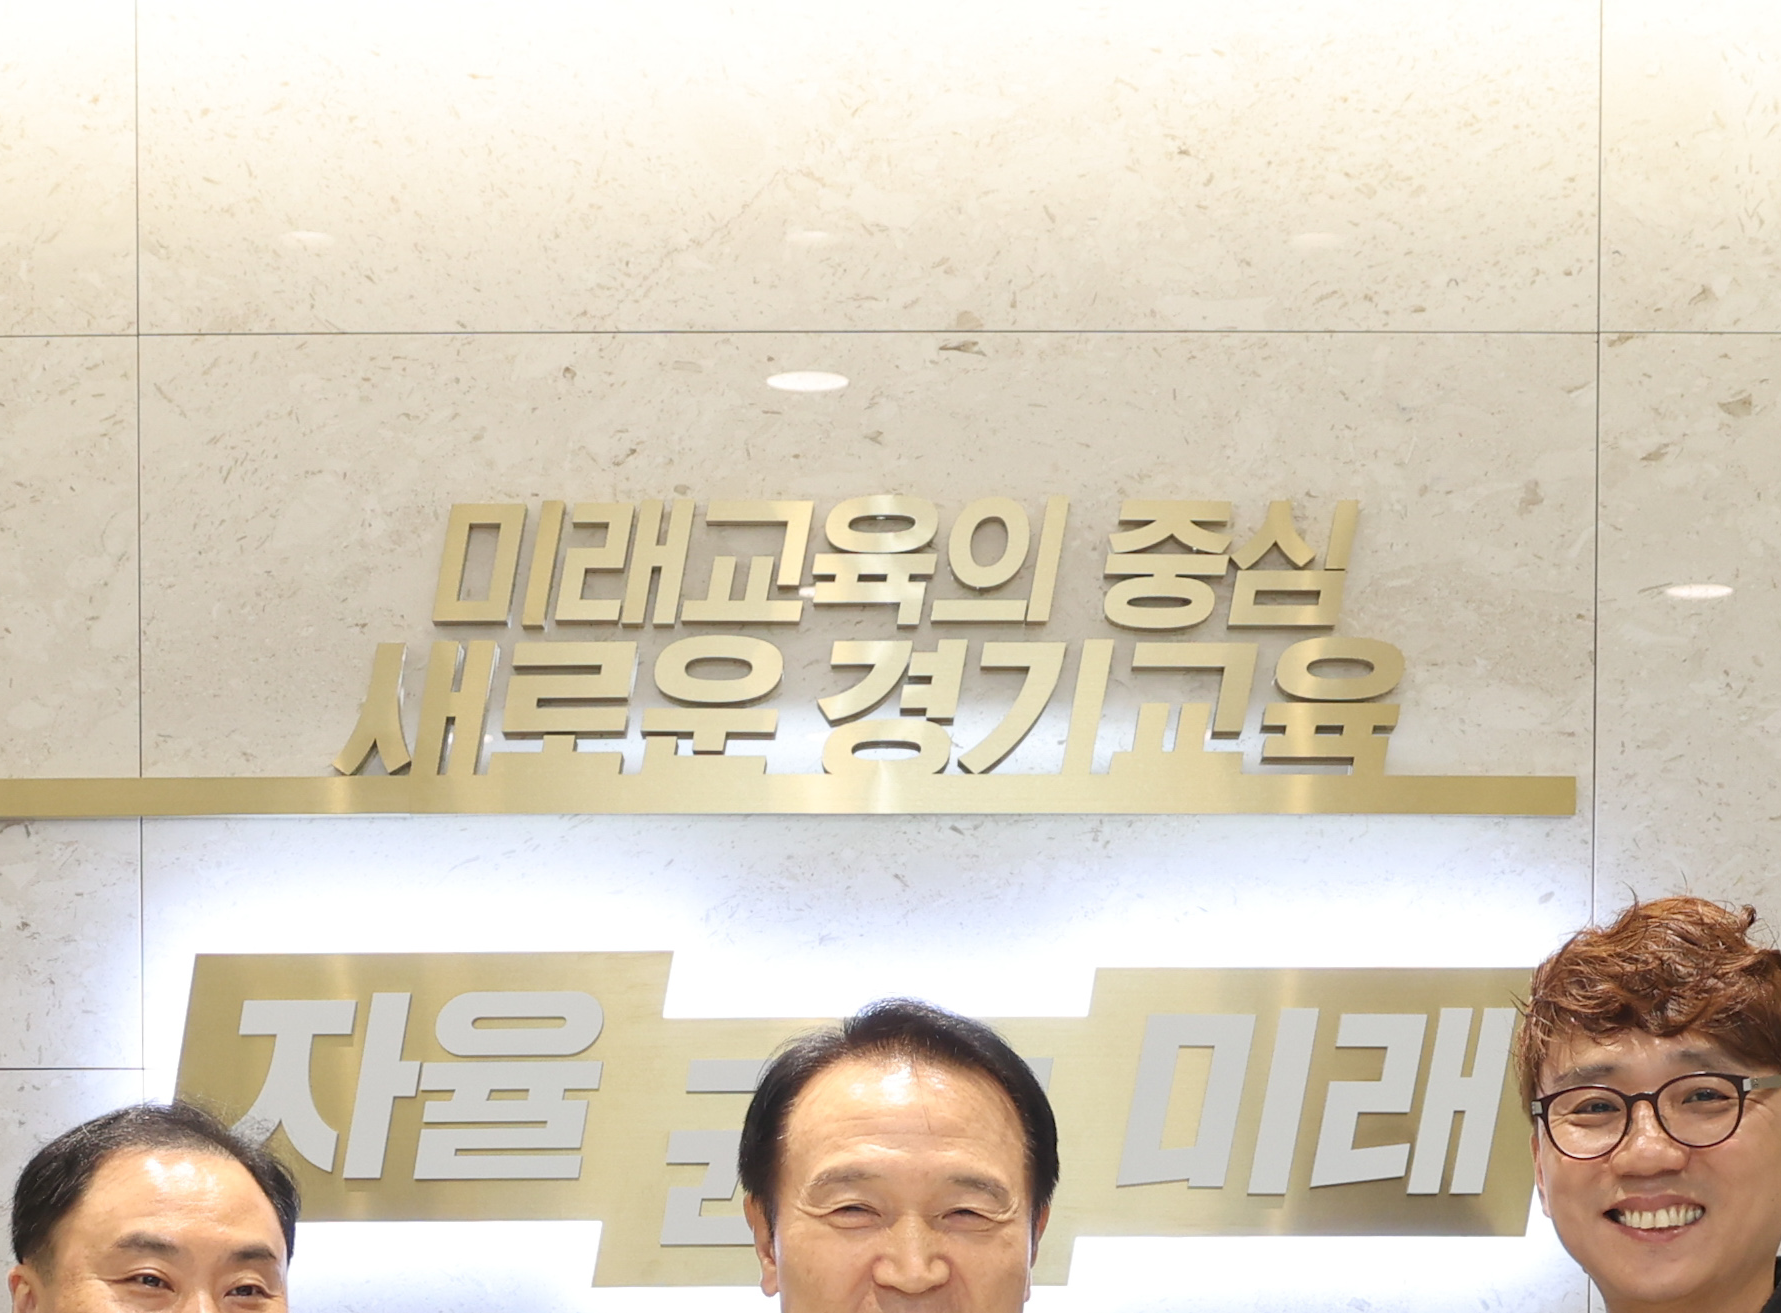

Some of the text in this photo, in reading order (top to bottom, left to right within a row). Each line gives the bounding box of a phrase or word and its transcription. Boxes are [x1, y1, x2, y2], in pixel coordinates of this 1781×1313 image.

[432, 494, 1359, 630] 미래교육의 중심
[331, 635, 1406, 776] 새로운 경기교육
[229, 991, 605, 1181] 자율
[1115, 1007, 1518, 1196] 미래
